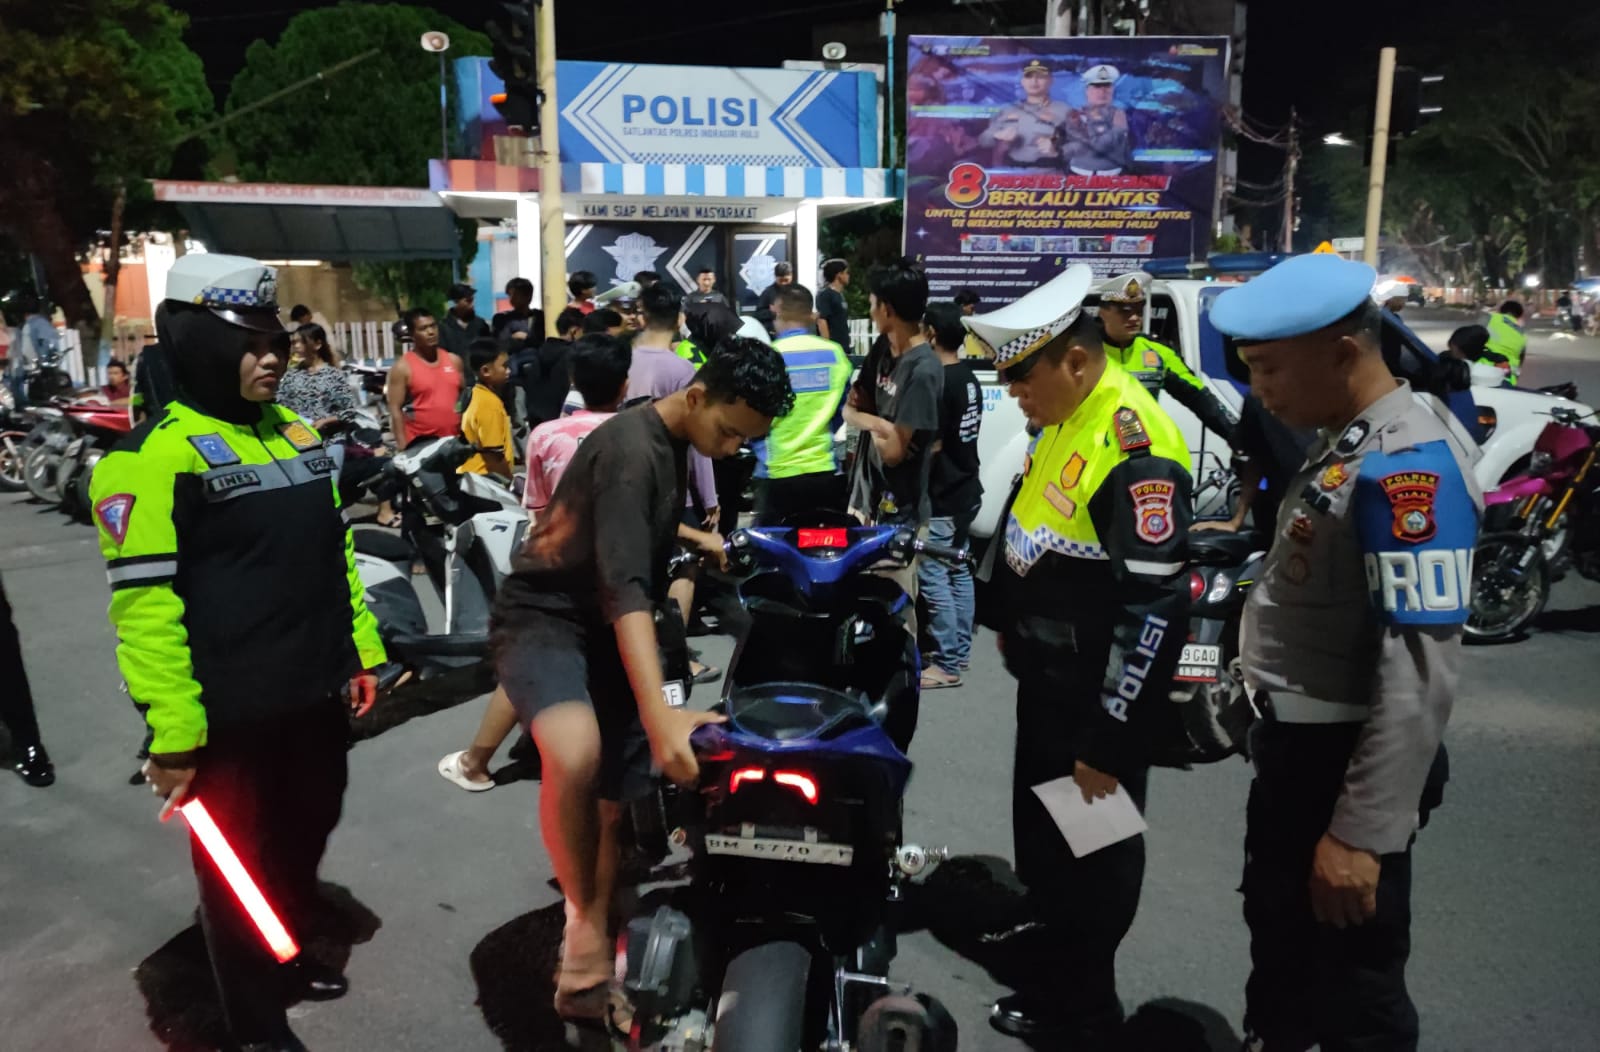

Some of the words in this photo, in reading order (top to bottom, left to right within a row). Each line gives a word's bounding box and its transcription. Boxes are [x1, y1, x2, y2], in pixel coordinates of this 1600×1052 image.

[623, 94, 758, 127] POLISI
[623, 127, 667, 137] SATLANTAS
[670, 128, 698, 138] POLRES
[701, 129, 738, 138] INDRAGIRI
[740, 130, 760, 139] HULU
[946, 164, 990, 207] 8
[988, 191, 1080, 206] BERLALU
[1084, 191, 1160, 206] LINTAS
[583, 205, 608, 217] KAMI
[613, 205, 637, 217] SIAP
[642, 205, 689, 218] MELAYANI
[695, 206, 758, 219] MASYARAKAT
[925, 209, 966, 218] UNTUK
[968, 209, 1055, 219] MENCIPTAKAN
[1016, 220, 1061, 229] POLRES
[1063, 220, 1123, 229] INDRAGIRI
[1126, 220, 1159, 229] HULU
[218, 473, 254, 488] INES
[1386, 473, 1435, 486] POLRES
[1136, 483, 1168, 496] POLDA
[1105, 613, 1169, 722] POLISI
[709, 839, 739, 849] BM
